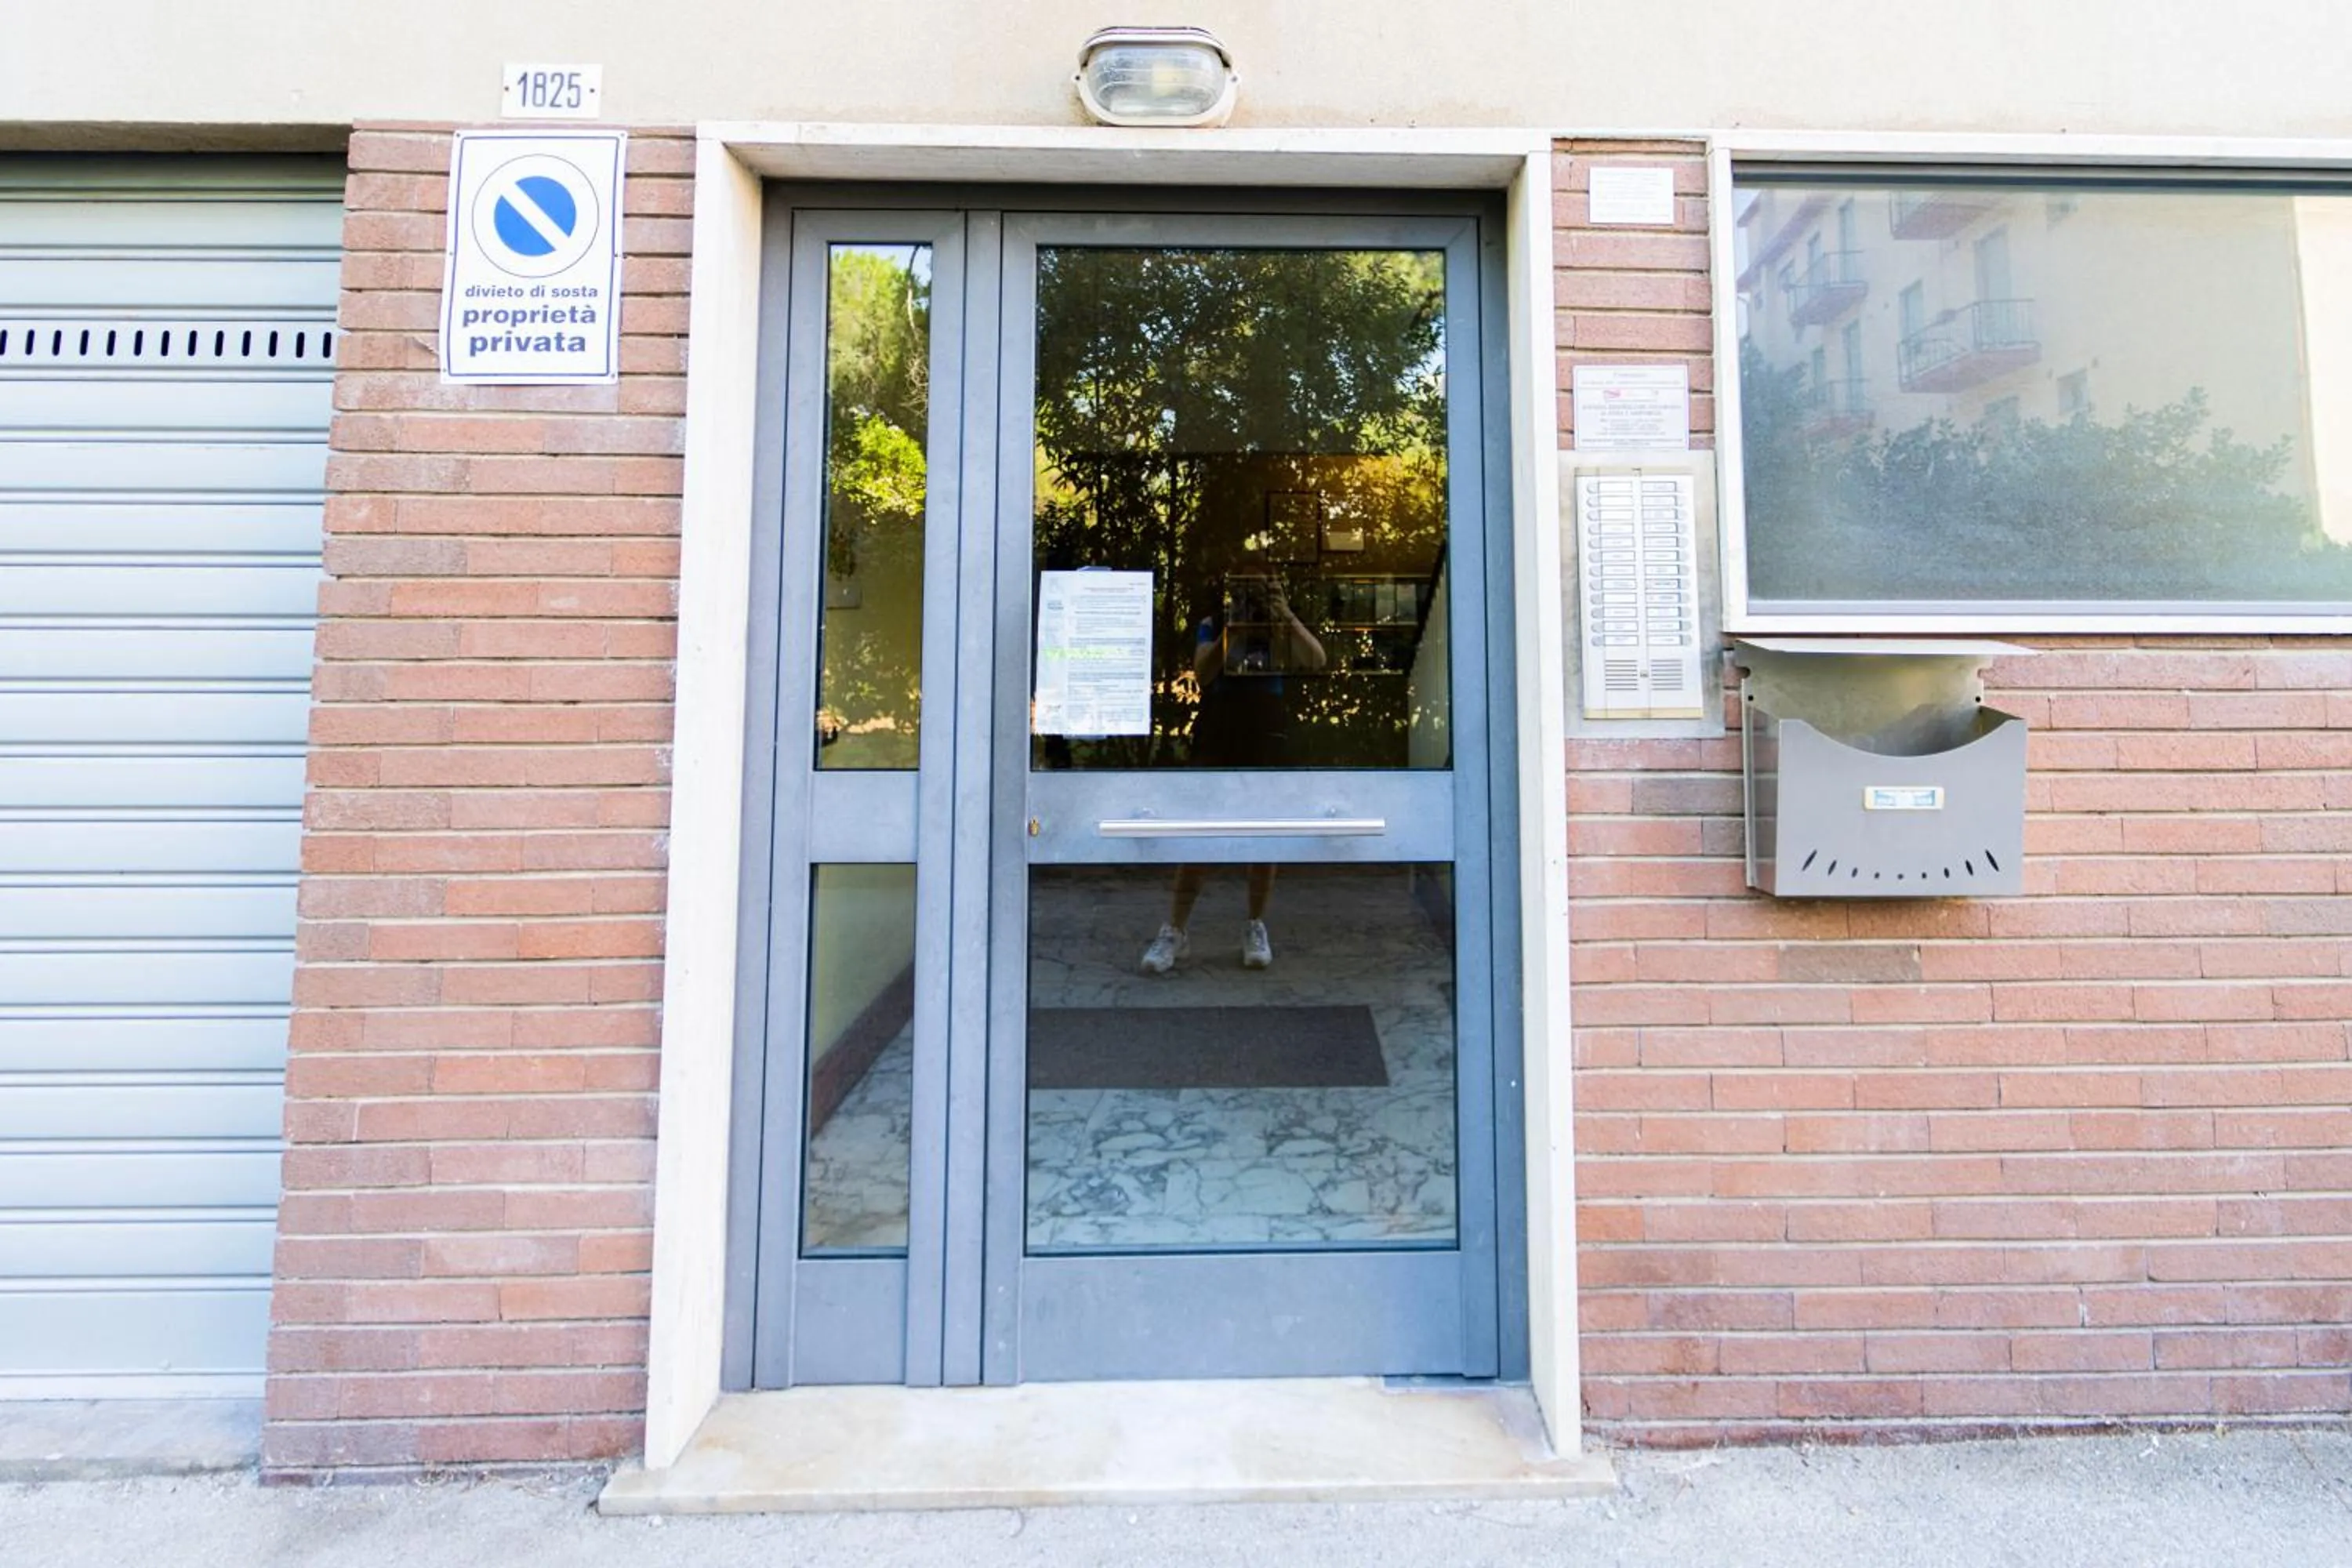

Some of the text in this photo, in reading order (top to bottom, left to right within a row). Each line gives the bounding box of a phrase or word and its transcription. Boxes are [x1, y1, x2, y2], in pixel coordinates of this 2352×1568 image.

[517, 71, 582, 108] 1825
[465, 285, 598, 298] divieto di sosta
[462, 304, 597, 328] proprietà
[470, 330, 586, 357] privata
